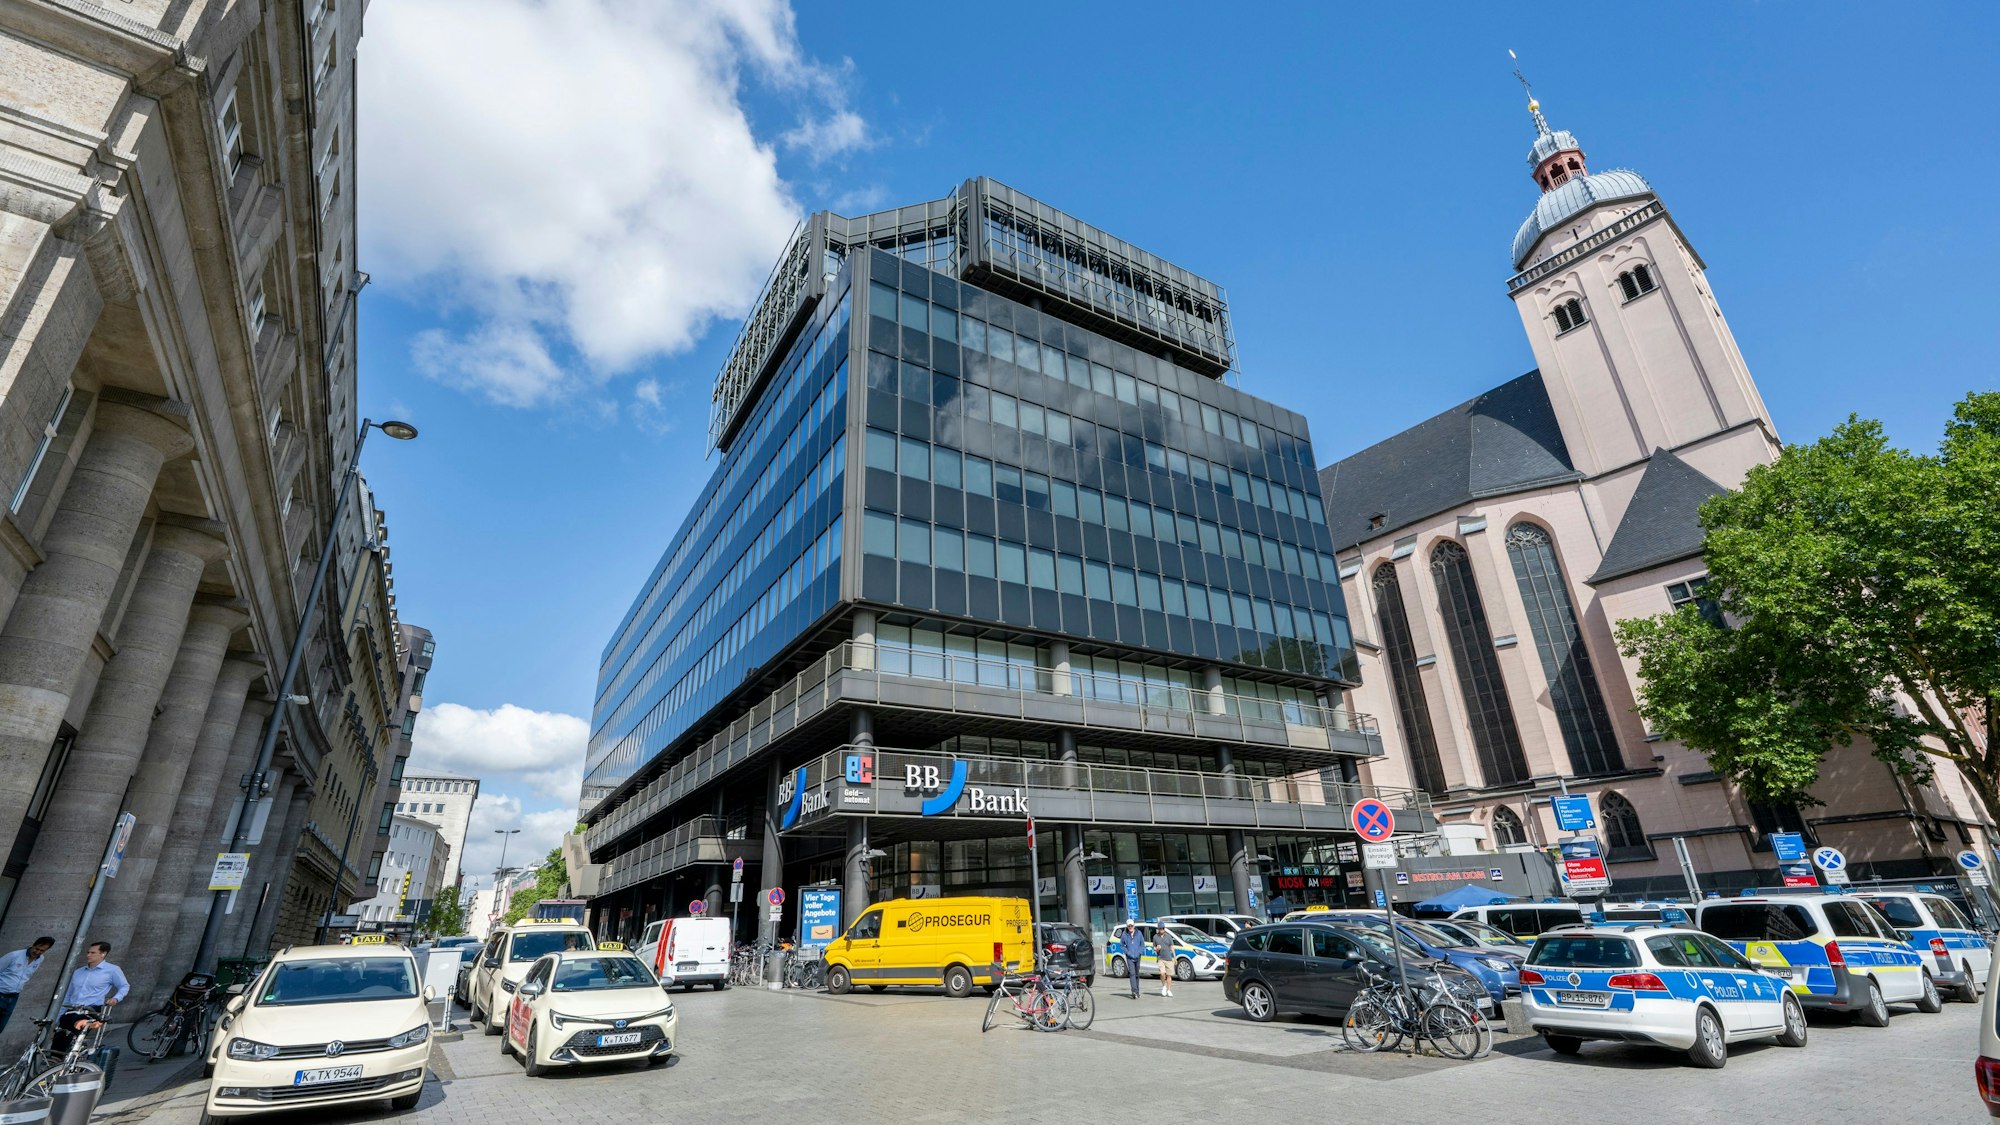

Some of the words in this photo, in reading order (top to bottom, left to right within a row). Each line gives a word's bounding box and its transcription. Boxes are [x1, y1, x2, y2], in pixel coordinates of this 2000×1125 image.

[844, 789, 864, 797] Geld-
[905, 764, 940, 789] BB
[969, 787, 1029, 813] Bank
[778, 781, 792, 806] BB
[801, 782, 828, 816] Bank
[844, 796, 870, 804] automat
[1411, 872, 1444, 882] BISTRO
[1446, 871, 1460, 881] AM
[1462, 870, 1486, 880] DOM
[1101, 883, 1115, 891] Bank
[1278, 877, 1306, 889] KIOSK
[1308, 877, 1320, 888] AM
[400, 873, 411, 907] HOTEL
[819, 894, 836, 903] Tage
[804, 909, 836, 918] Angebote
[925, 914, 991, 927] PROSEGUR
[359, 935, 380, 943] TAXI
[1714, 986, 1739, 998] POLIZEI
[603, 1036, 610, 1044] K
[302, 1071, 311, 1082] K
[318, 1070, 331, 1080] TX
[334, 1067, 360, 1079] 9544
